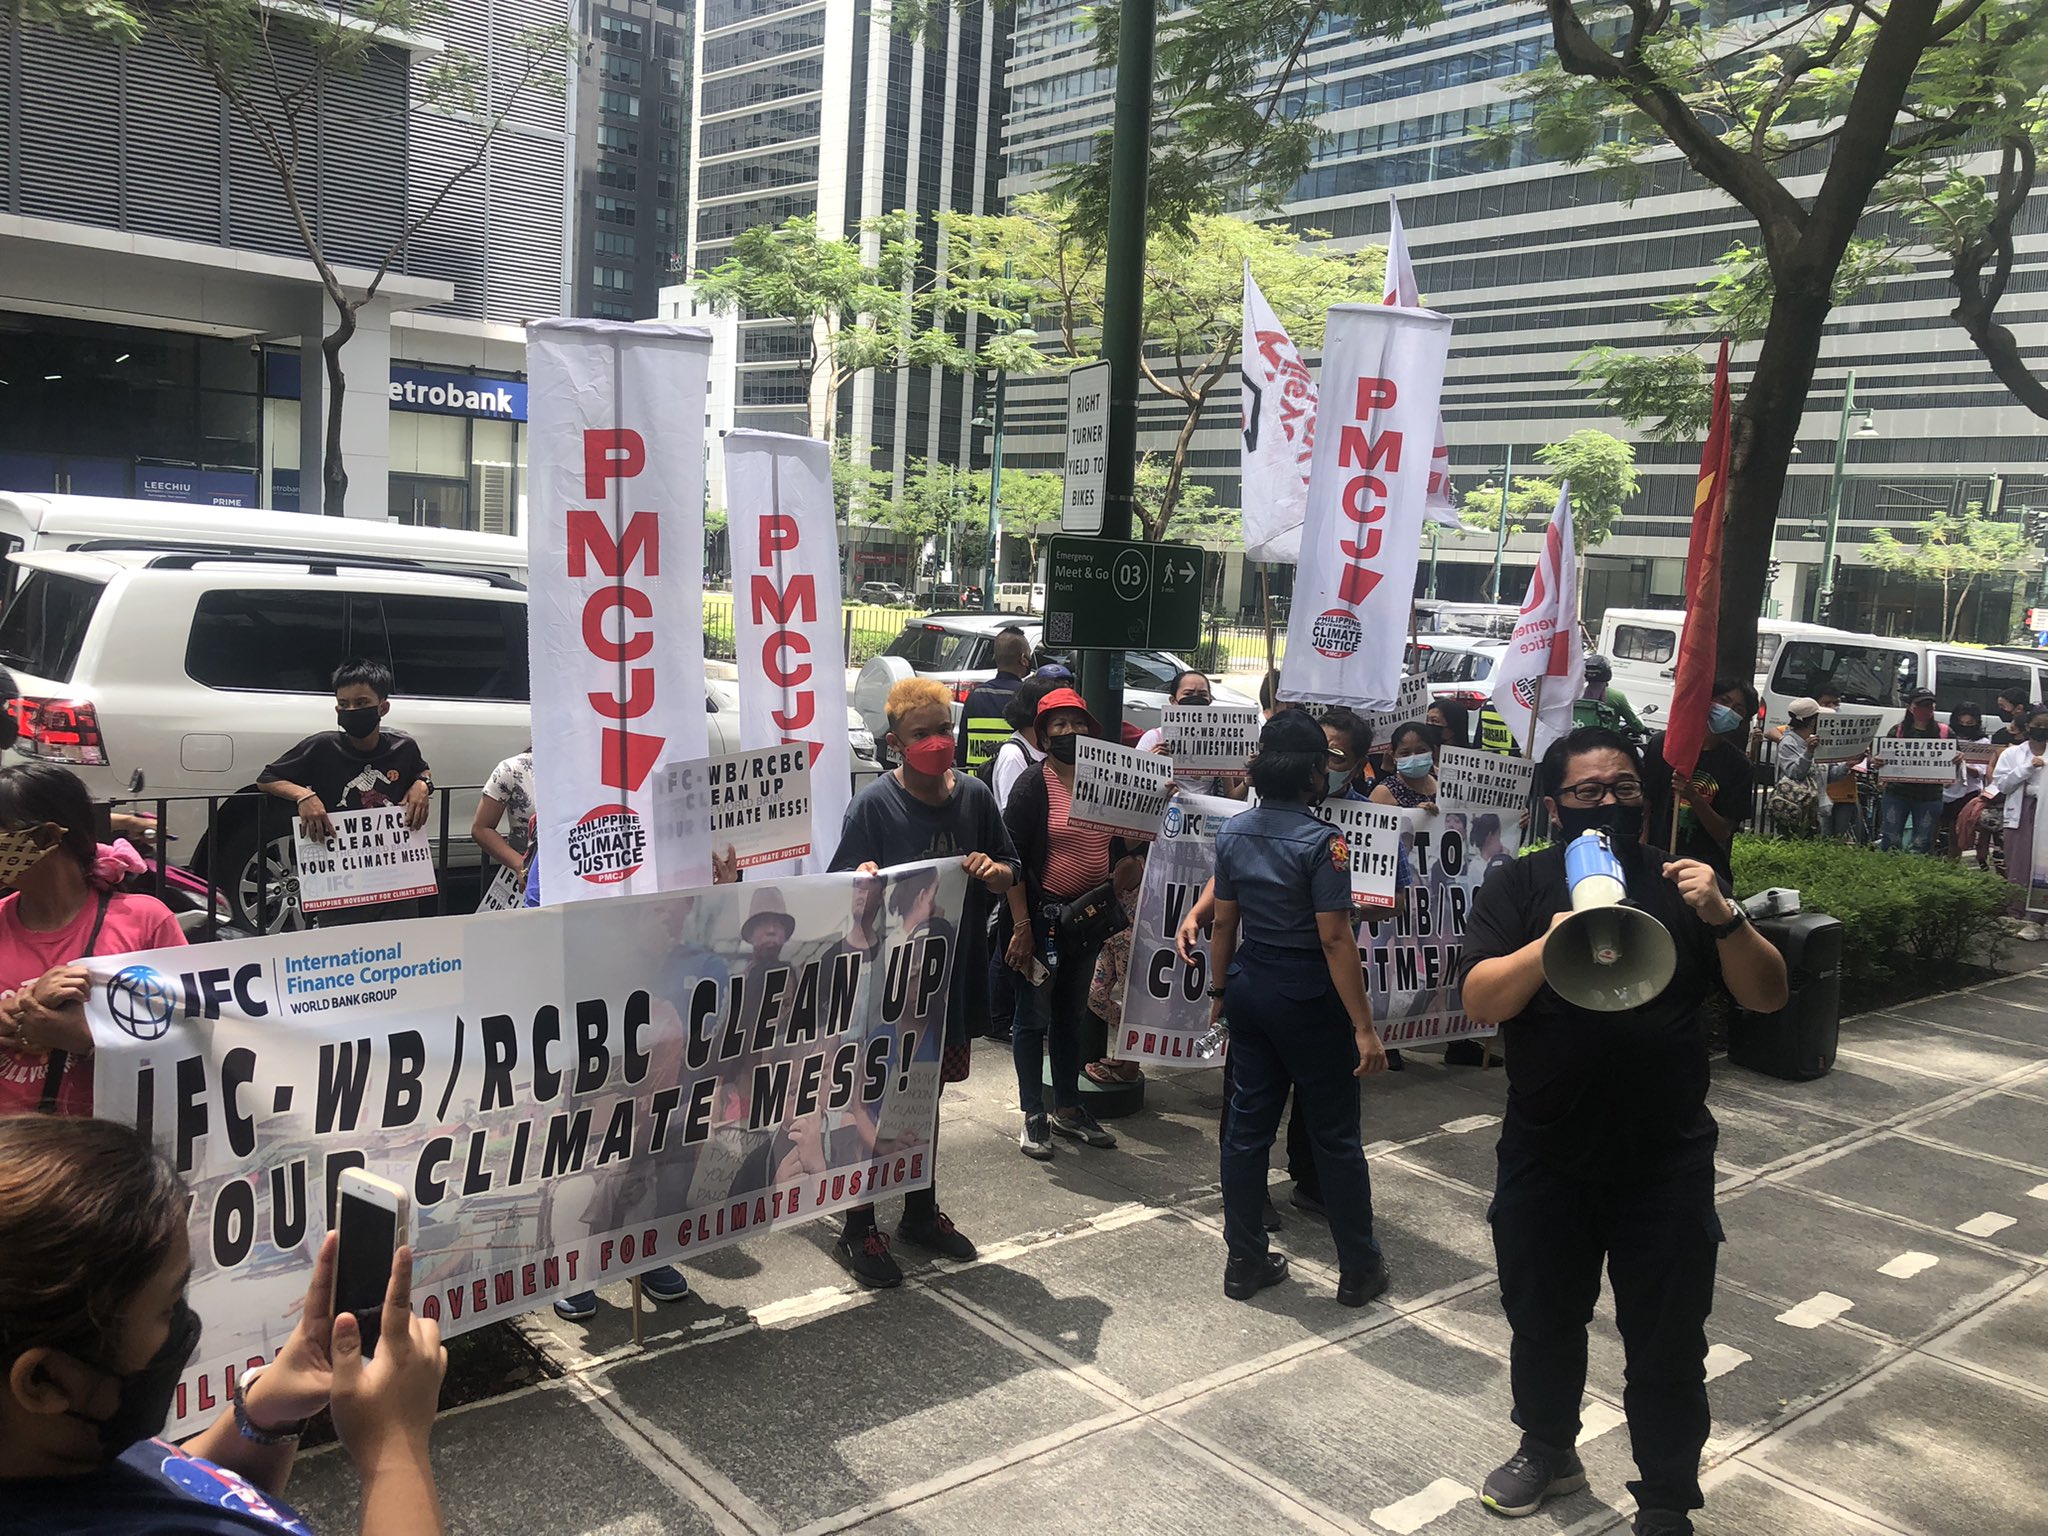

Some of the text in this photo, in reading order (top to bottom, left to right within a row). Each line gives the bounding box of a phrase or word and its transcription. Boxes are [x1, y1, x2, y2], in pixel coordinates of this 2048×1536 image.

[1077, 393, 1100, 414] RIGHT
[1072, 424, 1103, 445] TURNER
[1068, 456, 1104, 476] YIELD TO
[144, 481, 191, 491] LEECHIU
[213, 498, 242, 506] PRIME
[1072, 489, 1094, 506] BIKES
[1056, 550, 1094, 563] Emergency
[1055, 566, 1109, 580] Meet & Go
[1120, 564, 1141, 586] 03
[1054, 582, 1073, 592] Point
[1316, 616, 1361, 627] PHILIPPINE
[1312, 638, 1358, 652] JUSTICE
[1313, 627, 1363, 643] CLIMATE
[1164, 712, 1257, 724] JUSTICE TO VICTIMS
[1379, 711, 1409, 726] CLIMATE
[1180, 727, 1244, 738] IFC-WB/RCBC
[1166, 740, 1186, 755] OAL
[1882, 741, 1954, 750] IFC-WB/RCBC
[1078, 745, 1172, 778] JUSTICE TO VICTIMS
[1442, 753, 1532, 778] JUSTICE TO VICTIMS
[760, 778, 784, 797] UP
[1093, 767, 1158, 792] IFC-WB/RCBC
[1457, 770, 1517, 789] IFC-WB/RCBC
[1076, 780, 1167, 816] COAL INVESTMENTS!
[1440, 782, 1463, 800] COAL
[769, 798, 808, 820] MESS!
[569, 815, 639, 837] PHILIPPINE
[1182, 814, 1202, 836] IFC
[1340, 809, 1398, 831] VICTIMS
[326, 831, 410, 852] CLEAN UP
[568, 825, 625, 844] MOVEMENT
[569, 830, 646, 861] CLIMATE
[1413, 830, 1464, 877] TO
[300, 847, 430, 875] YOUR CLIMATE MESS!
[573, 847, 644, 877] JUSTICE
[736, 846, 806, 867] FOR CLIMATE JUSTICE
[1349, 850, 1395, 877] ENTS!
[326, 874, 354, 893] IFC
[598, 872, 624, 882] PMCJ
[305, 899, 342, 909] PHILIPPINE
[343, 894, 378, 905] MOVEMENT
[393, 889, 415, 898] CLIMATE
[416, 886, 434, 895] JUSTICE
[1363, 895, 1389, 904] JUSTICE
[284, 942, 402, 975] International
[287, 957, 462, 995] Finance Corporation
[181, 963, 269, 1020] IFC
[290, 988, 398, 1015] WORLD BANK GROUP
[686, 952, 862, 1071] CLEAN
[881, 936, 948, 1026] UP
[1383, 1018, 1440, 1042] CLIMATE
[414, 1077, 718, 1207] CLIMATE
[748, 1032, 916, 1132] MESS!
[412, 1250, 580, 1325] OVEMENT
[600, 1228, 657, 1271] FOR
[678, 1186, 800, 1246] CLIMATE
[817, 1152, 924, 1207] JUSTICE
